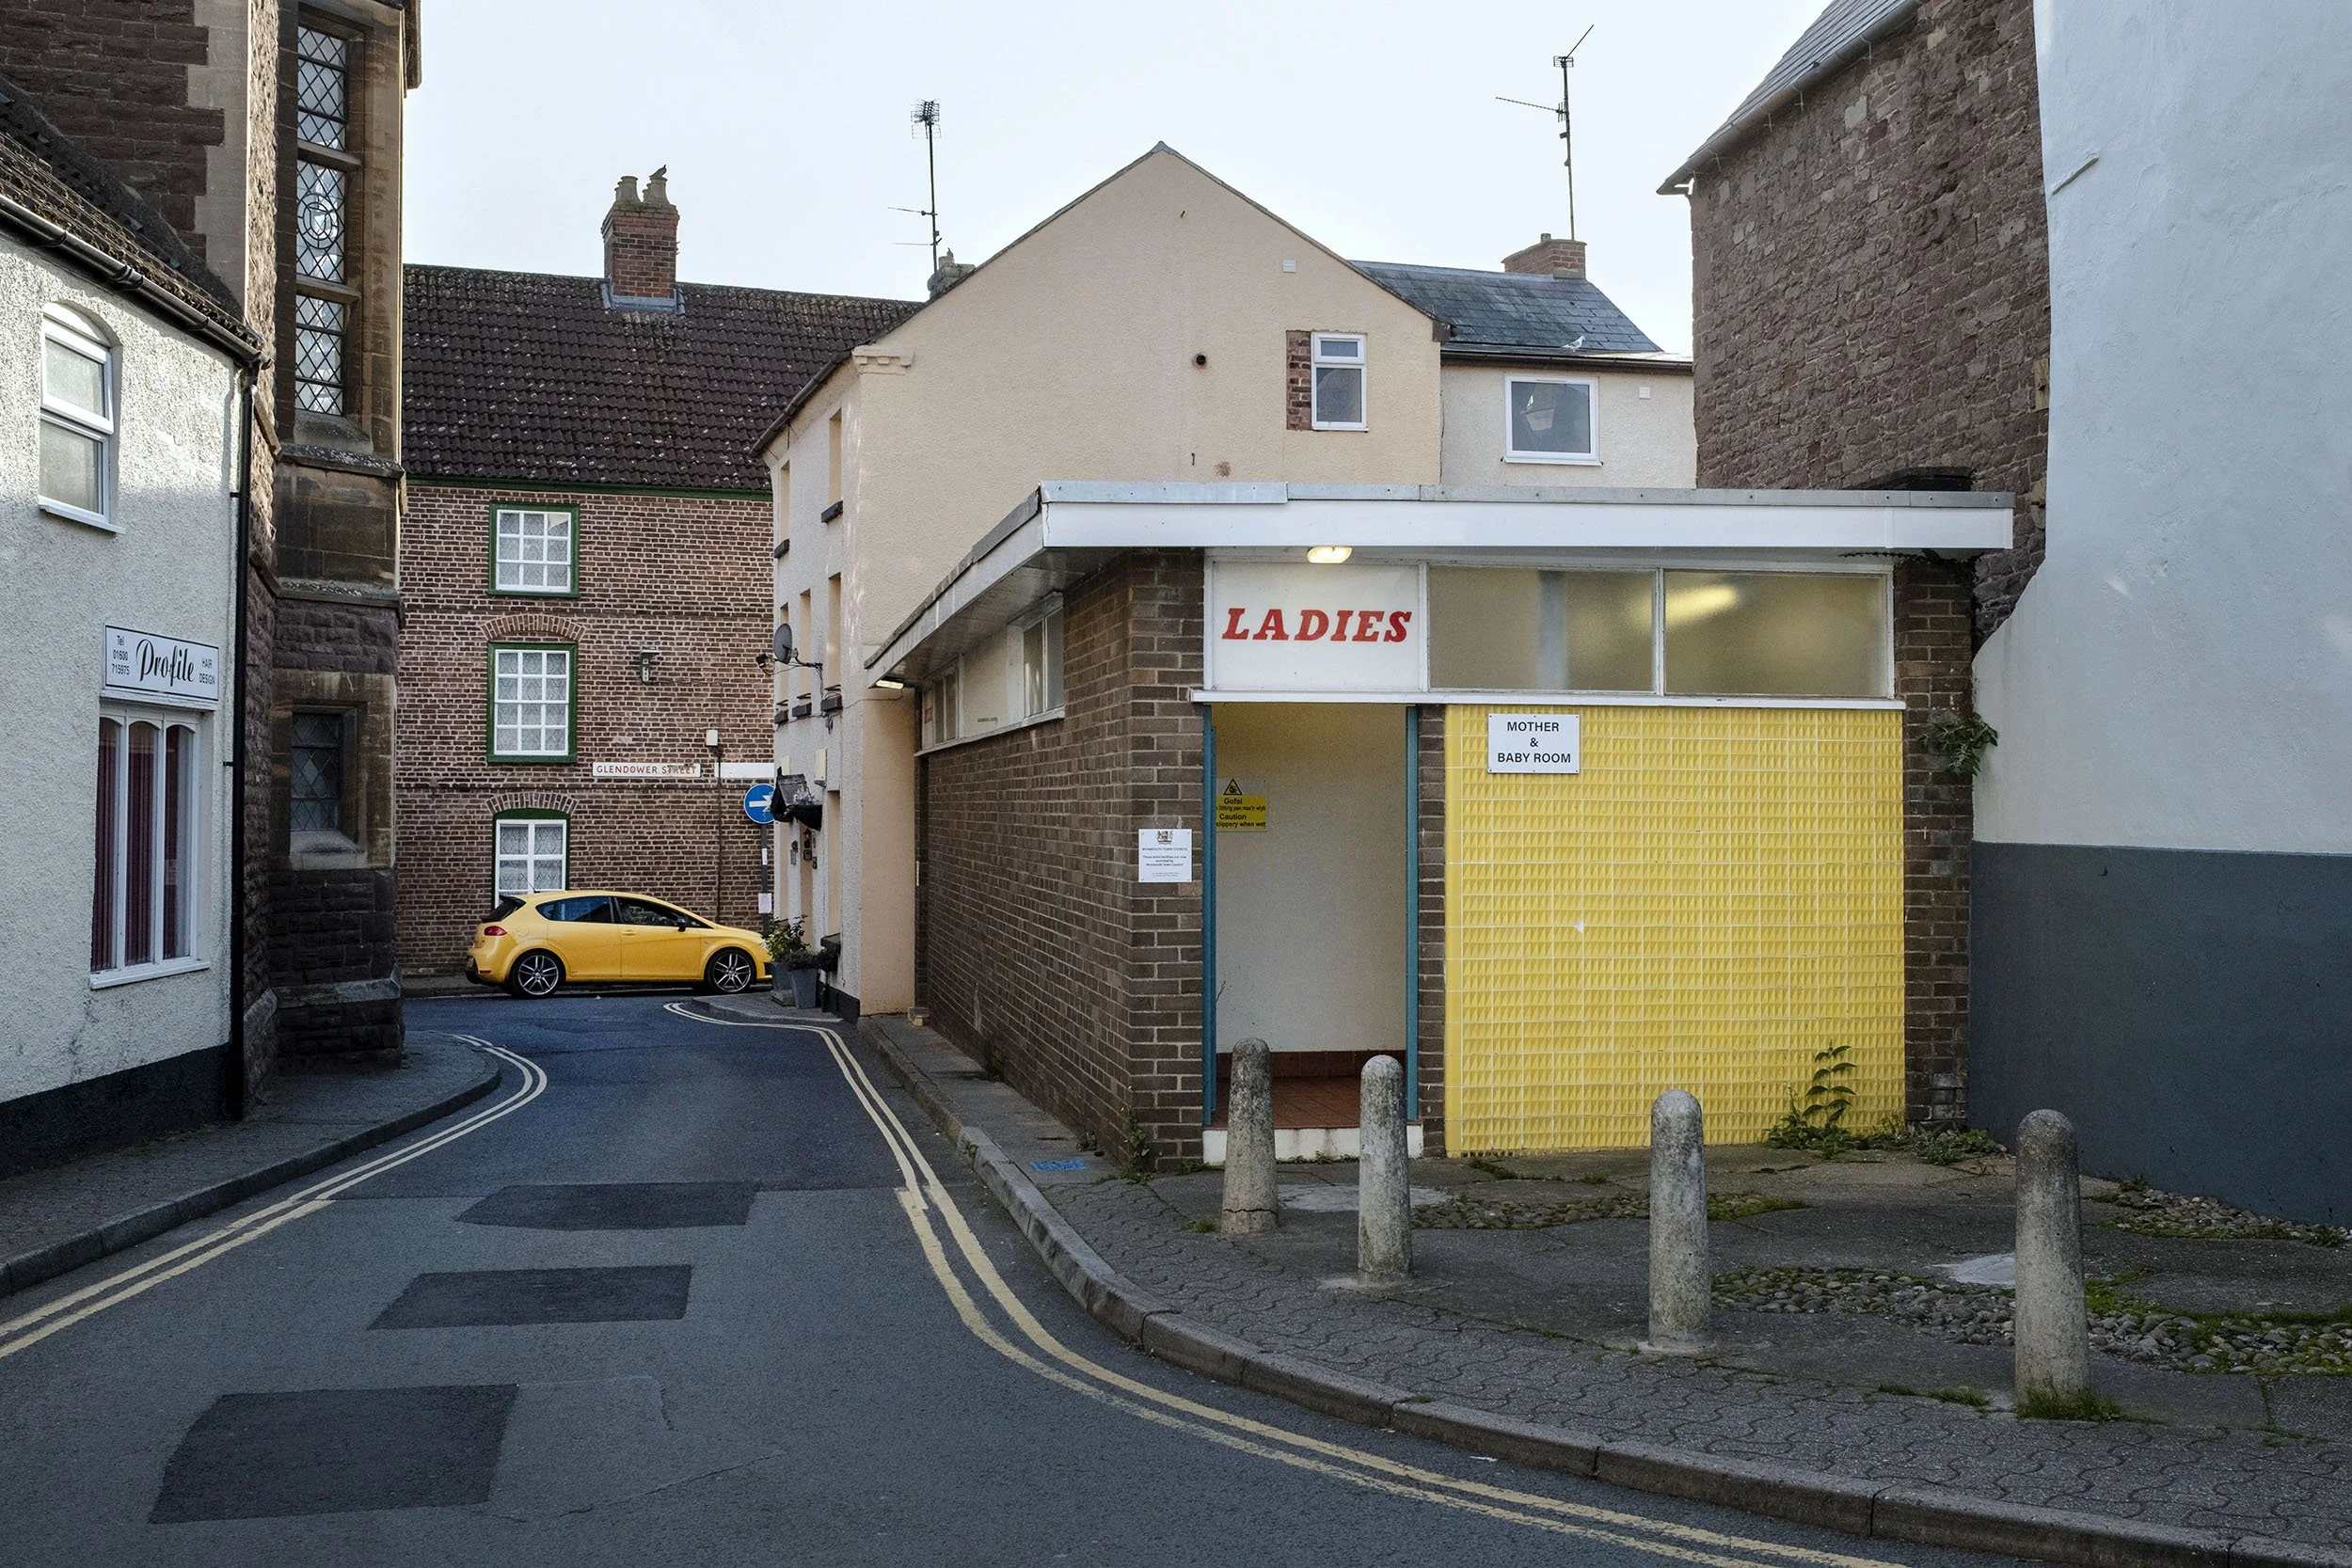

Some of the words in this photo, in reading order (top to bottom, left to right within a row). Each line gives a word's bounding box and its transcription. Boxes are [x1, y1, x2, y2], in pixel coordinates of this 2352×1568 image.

[1221, 608, 1412, 642] LADIES
[135, 639, 195, 687] Profile
[1506, 721, 1560, 732] MOTHER
[1530, 736, 1539, 748] &
[1497, 752, 1531, 763] BABY
[1534, 752, 1571, 763] ROOM
[596, 765, 658, 774] GLENDOWER
[661, 765, 696, 774] STREET
